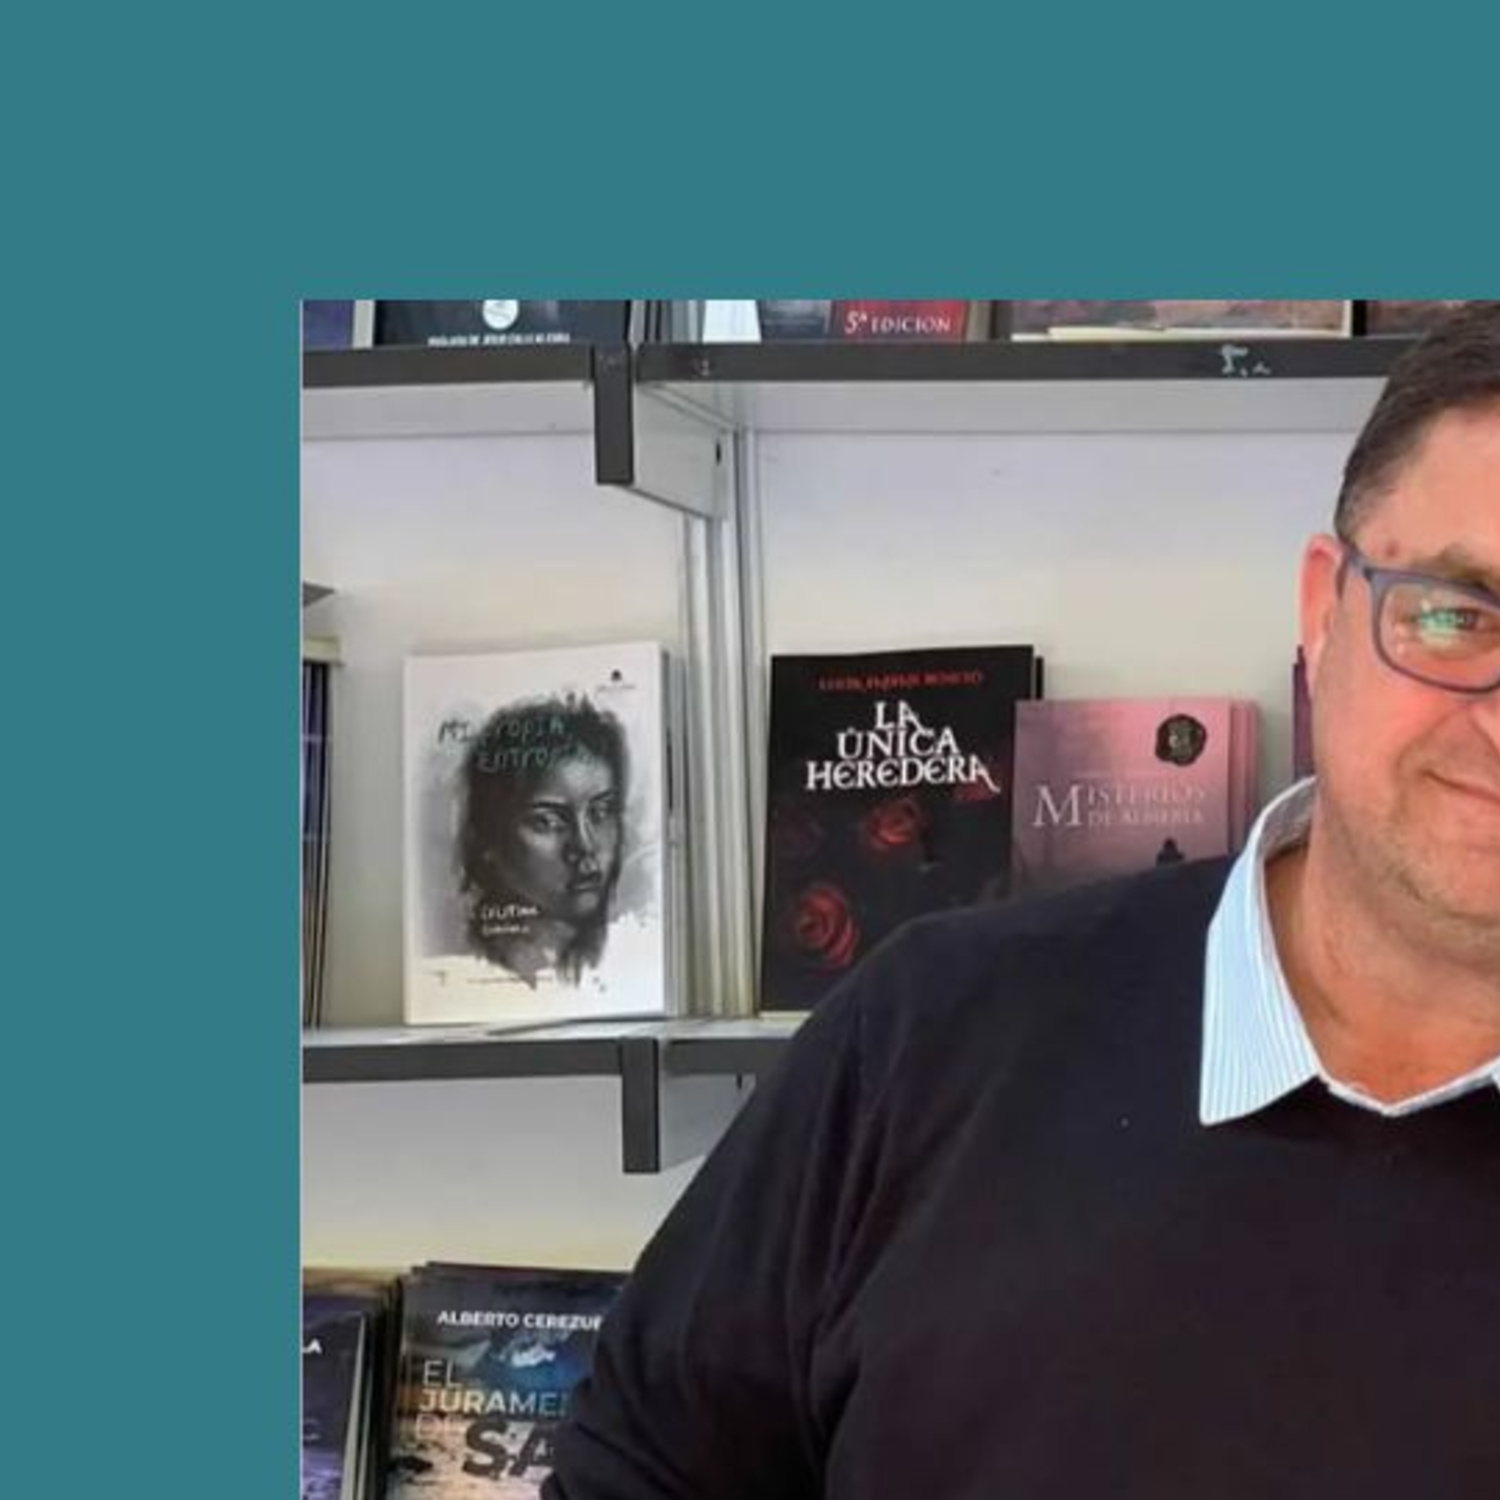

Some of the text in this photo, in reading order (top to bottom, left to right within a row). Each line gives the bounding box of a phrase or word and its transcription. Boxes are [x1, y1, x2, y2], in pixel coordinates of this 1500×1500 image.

[875, 700, 934, 737] LA
[837, 726, 962, 760] ÚNICA
[806, 753, 1000, 793] HEREDERA
[438, 1310, 519, 1327] ALBERTO
[423, 1360, 462, 1388] EL
